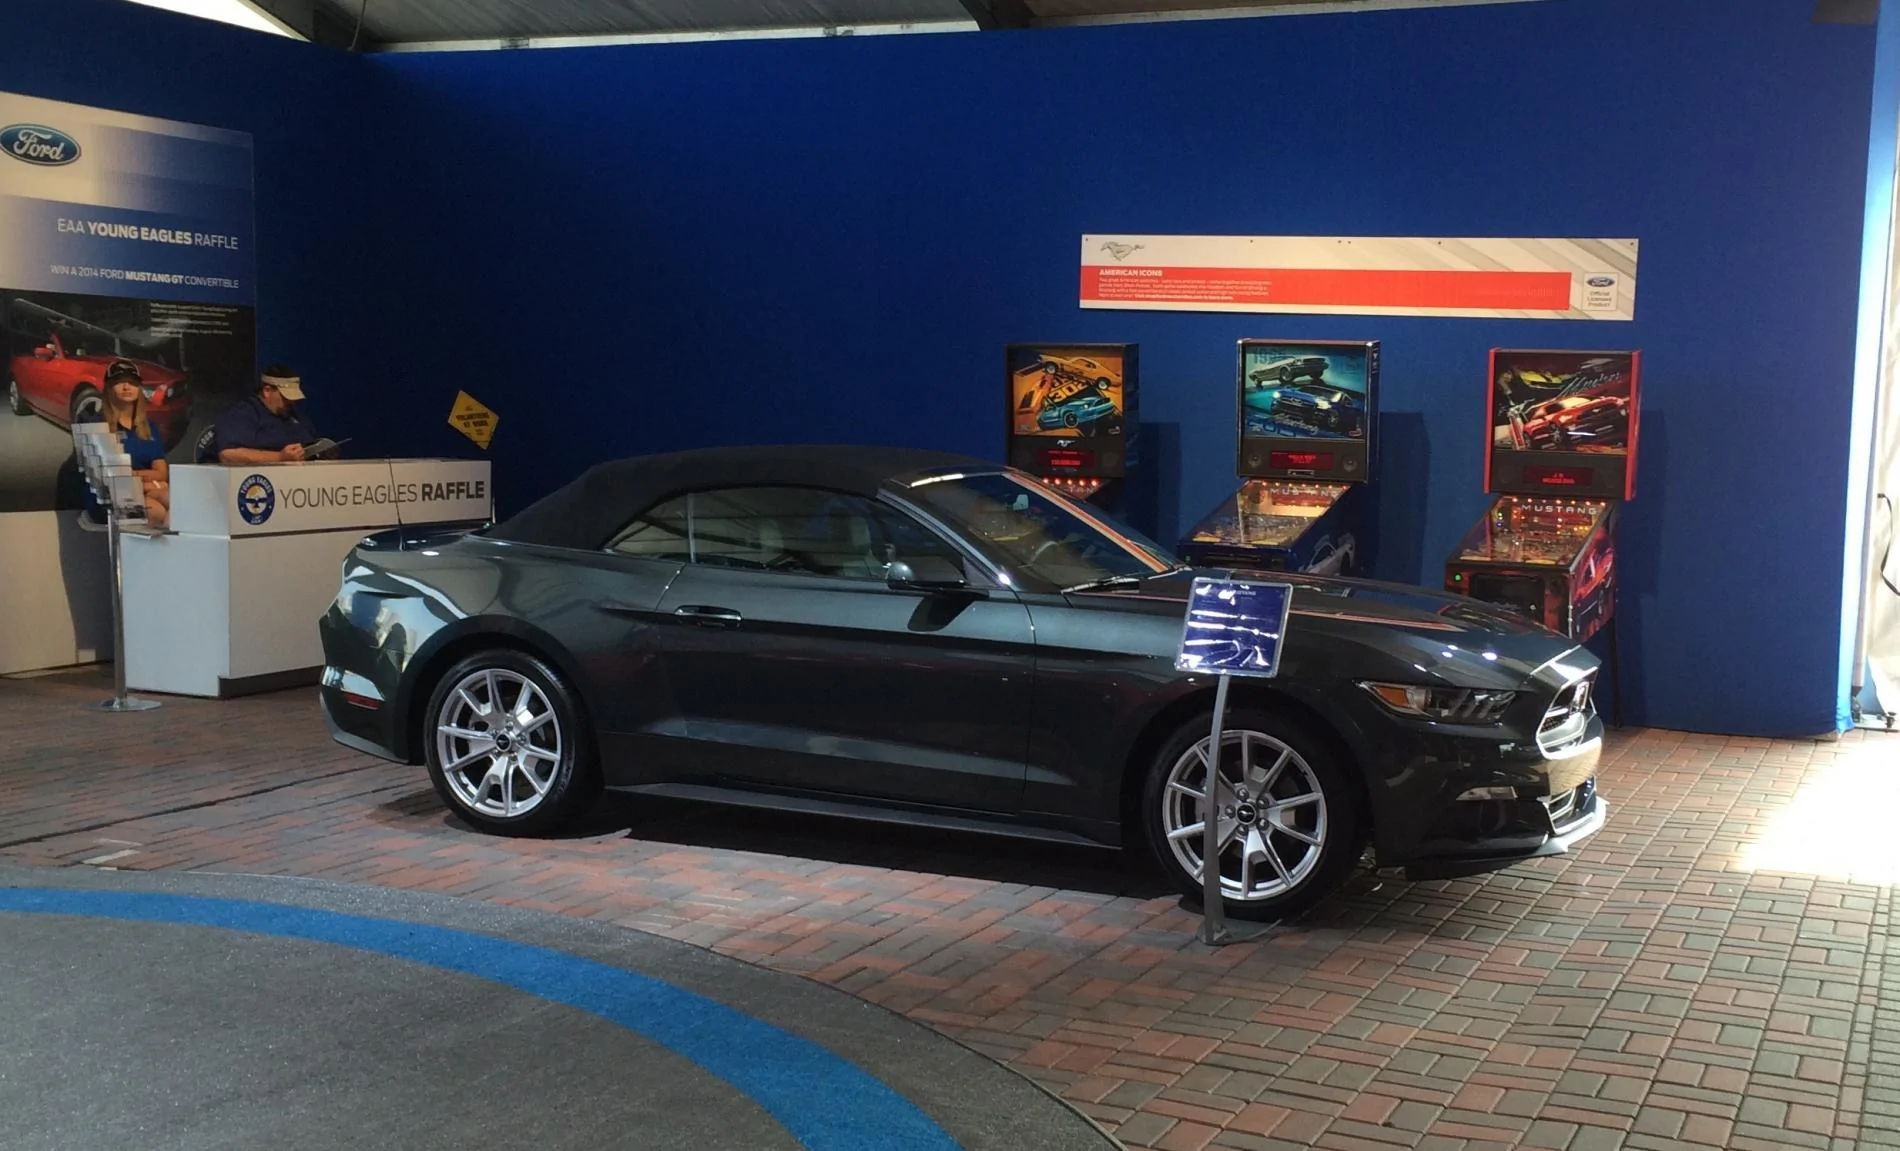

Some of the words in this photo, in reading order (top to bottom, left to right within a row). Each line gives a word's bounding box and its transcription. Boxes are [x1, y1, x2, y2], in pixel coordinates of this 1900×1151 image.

[13, 129, 64, 161] Ford
[57, 218, 86, 233] EAA
[87, 221, 139, 240] YOUNG
[140, 227, 192, 245] EAGLES
[194, 232, 239, 250] RAFFLE
[49, 264, 69, 275] WIN
[70, 266, 78, 276] A
[78, 266, 99, 277] 2014
[99, 268, 125, 280] FORD
[125, 270, 172, 284] MUSTANG
[171, 274, 184, 285] GT
[184, 275, 239, 289] CONVERTIBLE
[1099, 268, 1139, 277] AMERICAN
[1139, 269, 1163, 277] ICONS
[280, 487, 348, 509] YOUNG
[352, 484, 418, 506] EAGLES
[421, 480, 485, 502] RAFFLE
[1522, 504, 1598, 515] MUSTANG
